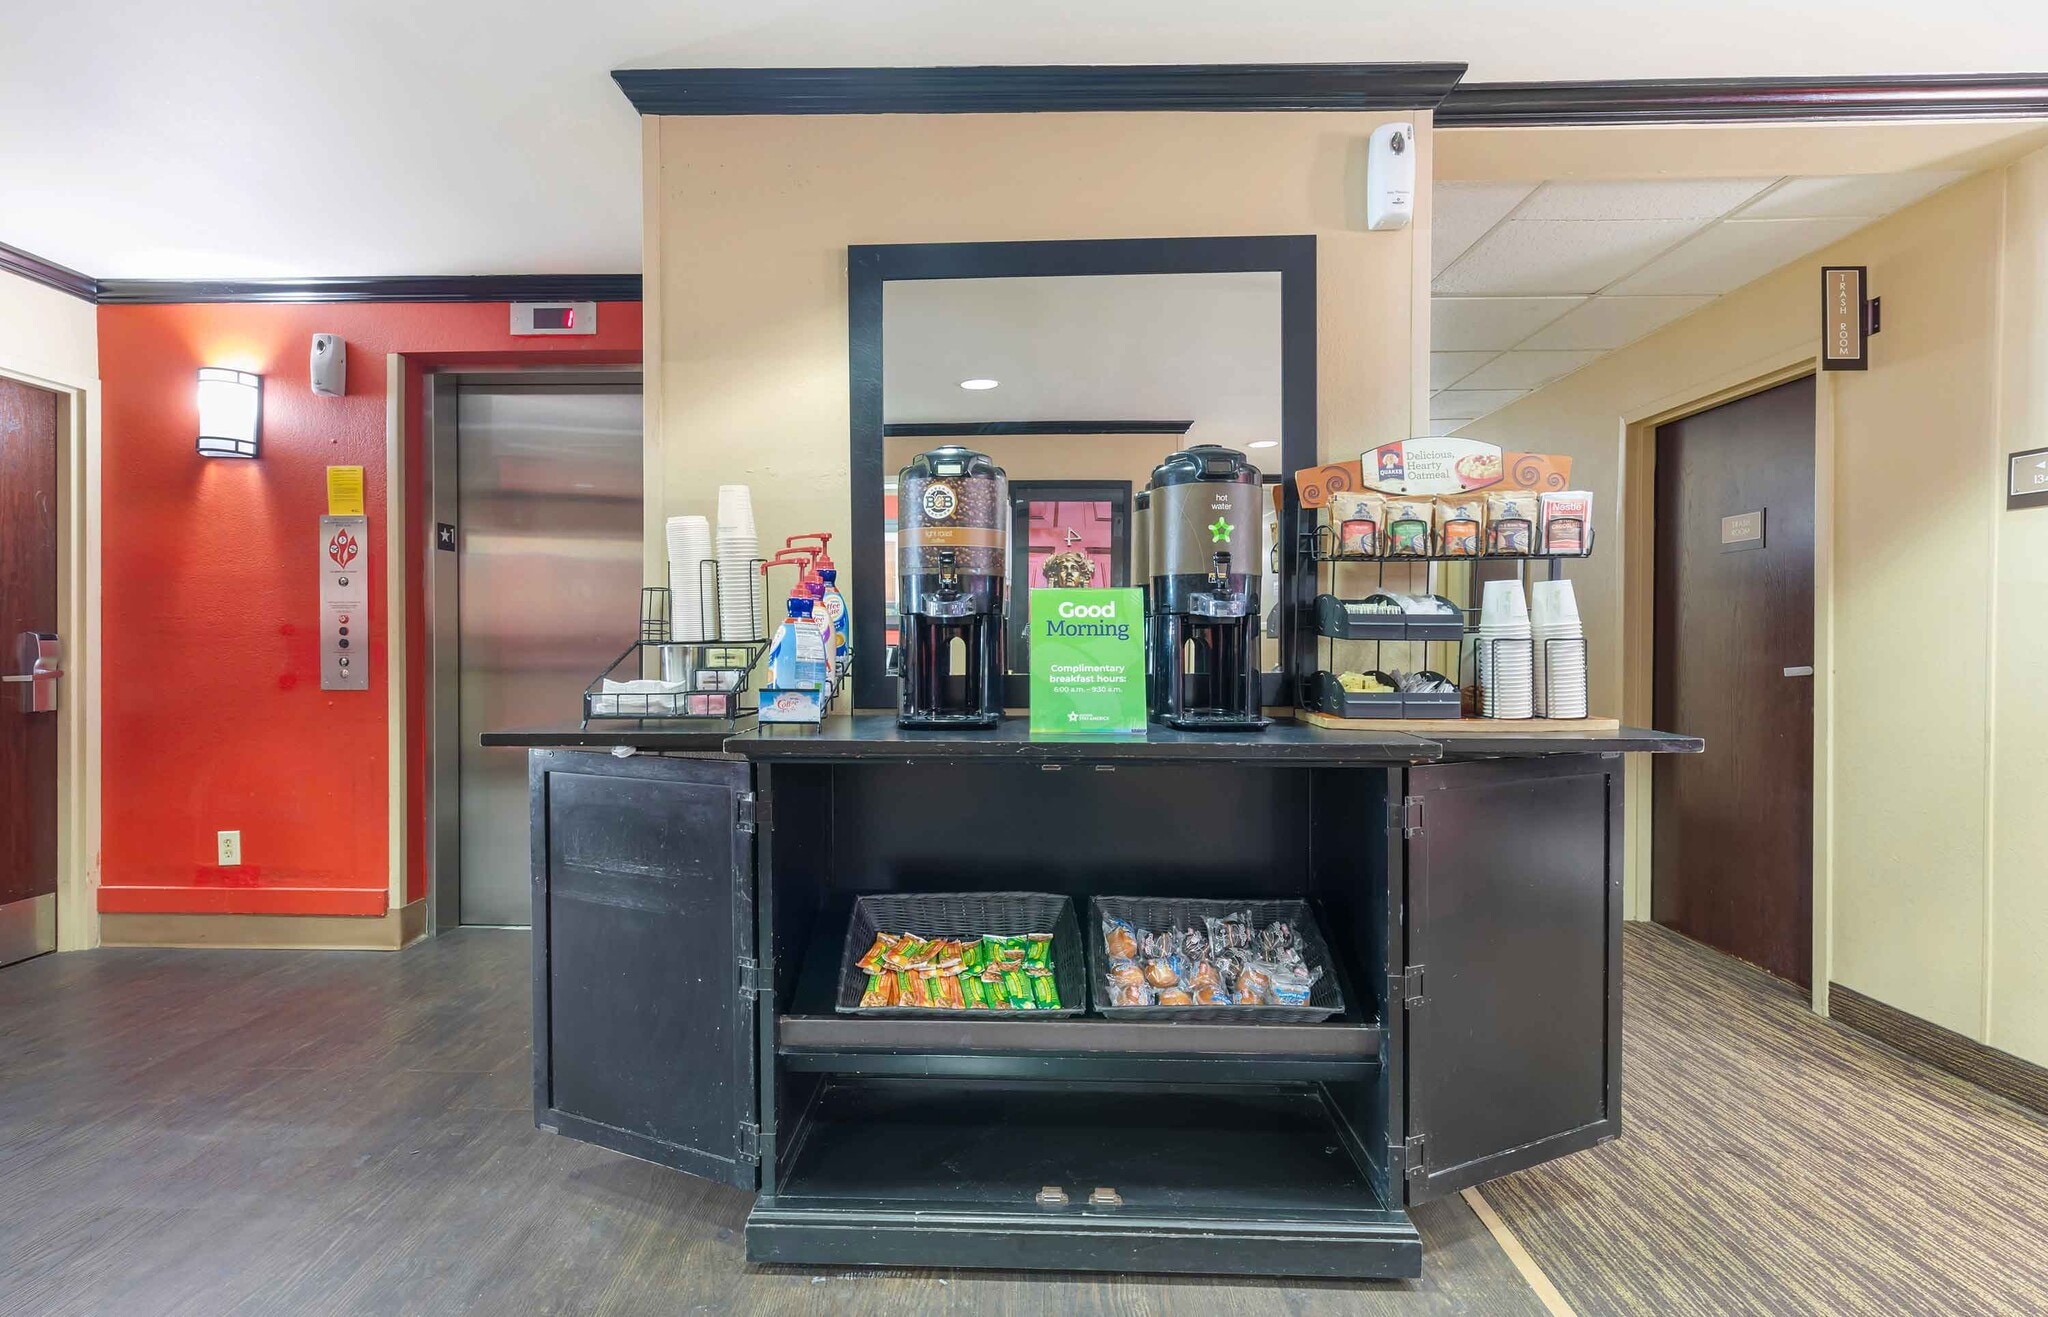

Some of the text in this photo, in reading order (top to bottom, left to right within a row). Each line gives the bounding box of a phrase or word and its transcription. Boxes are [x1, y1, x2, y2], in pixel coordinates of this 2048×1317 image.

[1839, 274, 1849, 355] TRASH ROOM
[1406, 450, 1455, 461] Delicious,
[1407, 461, 1442, 471] Hearty
[1379, 468, 1403, 476] QUAKER
[1408, 470, 1449, 480] Oatmeal
[1058, 600, 1115, 618] Good
[1046, 619, 1130, 641] Morning
[1050, 664, 1125, 673] Complimentary
[1049, 675, 1127, 683] breakfast hours:
